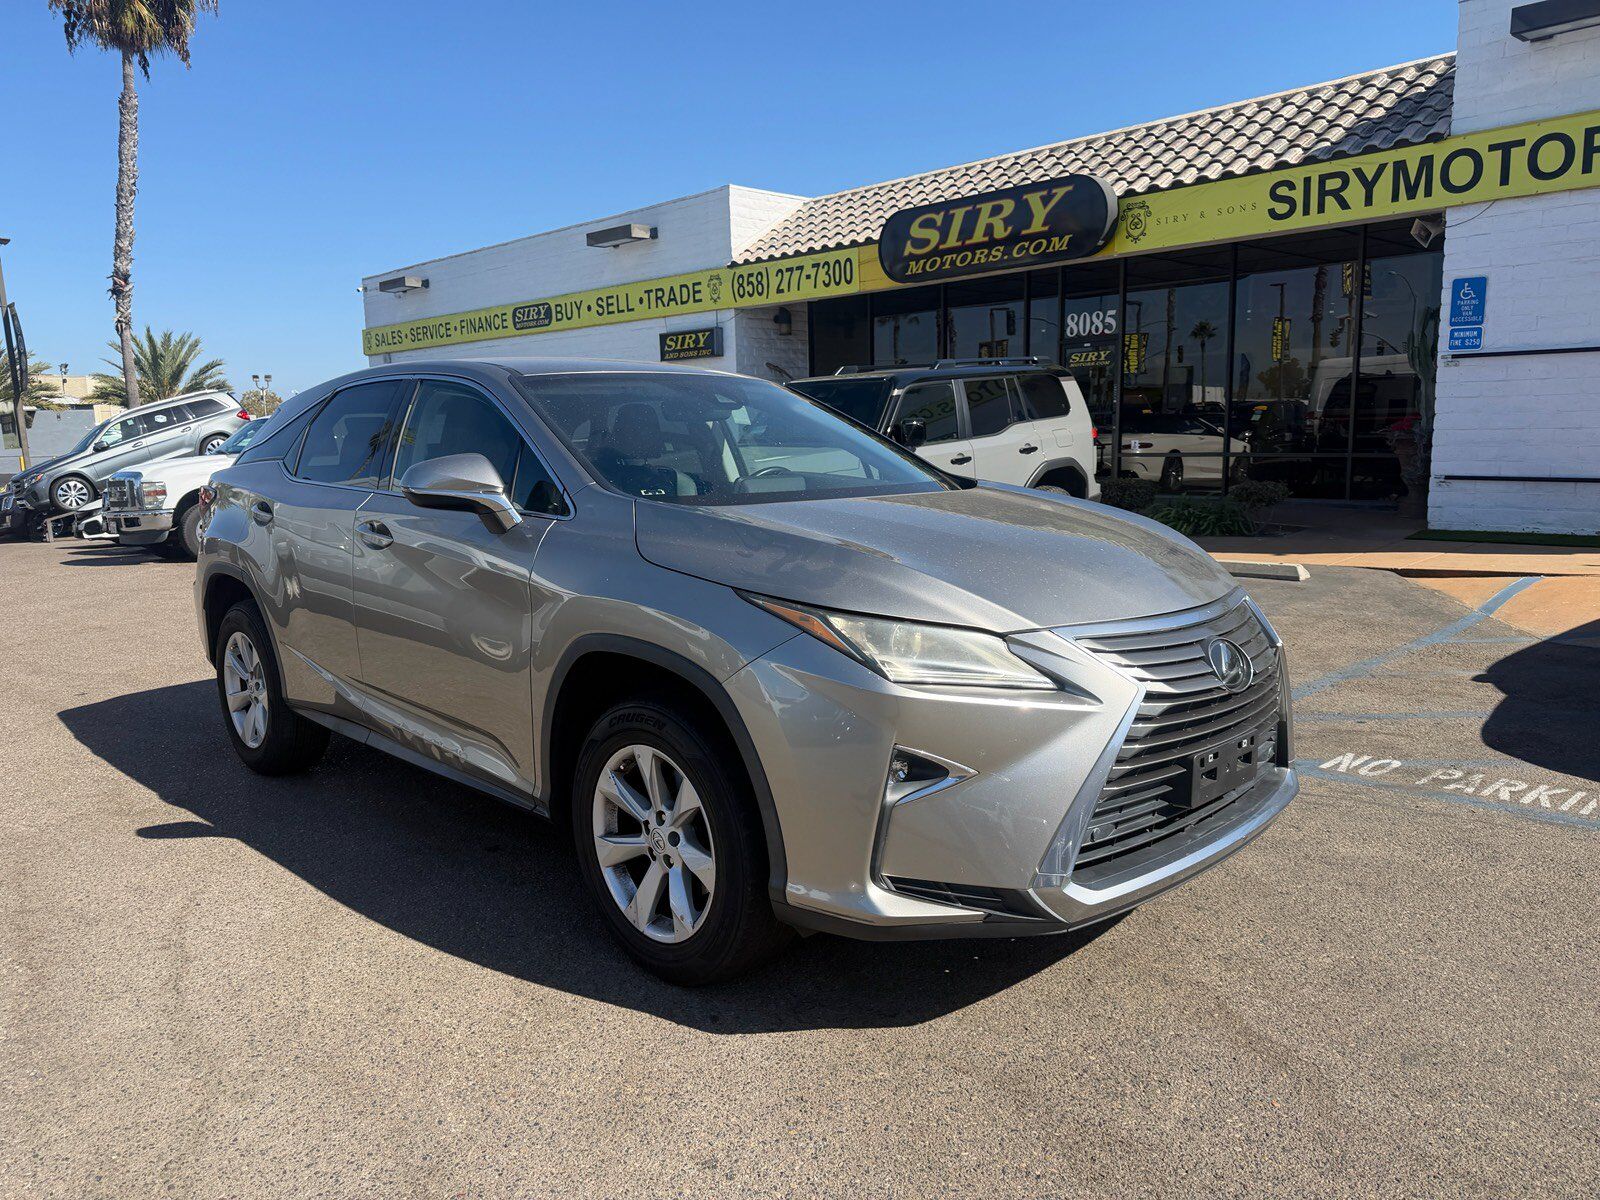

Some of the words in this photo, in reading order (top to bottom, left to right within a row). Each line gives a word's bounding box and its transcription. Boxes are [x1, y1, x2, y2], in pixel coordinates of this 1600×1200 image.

[904, 185, 1074, 256] SIRY
[1155, 213, 1189, 226] SIRY
[1216, 202, 1257, 217] SONS
[905, 235, 1071, 276] MOTORS.COM
[731, 270, 771, 303] (858)
[776, 256, 854, 295] 277-7300
[515, 304, 549, 323] SIRY
[554, 300, 583, 322] BUY
[595, 293, 635, 317] SELL
[644, 281, 703, 310] TRADE
[374, 329, 404, 348] SALES
[409, 322, 452, 343] SERVICE
[459, 312, 509, 336] FINANCE
[1066, 309, 1117, 338] 8085
[1451, 315, 1482, 323] ACCESSIBLE
[664, 331, 711, 351] SIRY
[1465, 338, 1480, 346] $250
[680, 350, 698, 358] SONS
[1069, 350, 1111, 363] SIRY
[1318, 752, 1402, 777] NO
